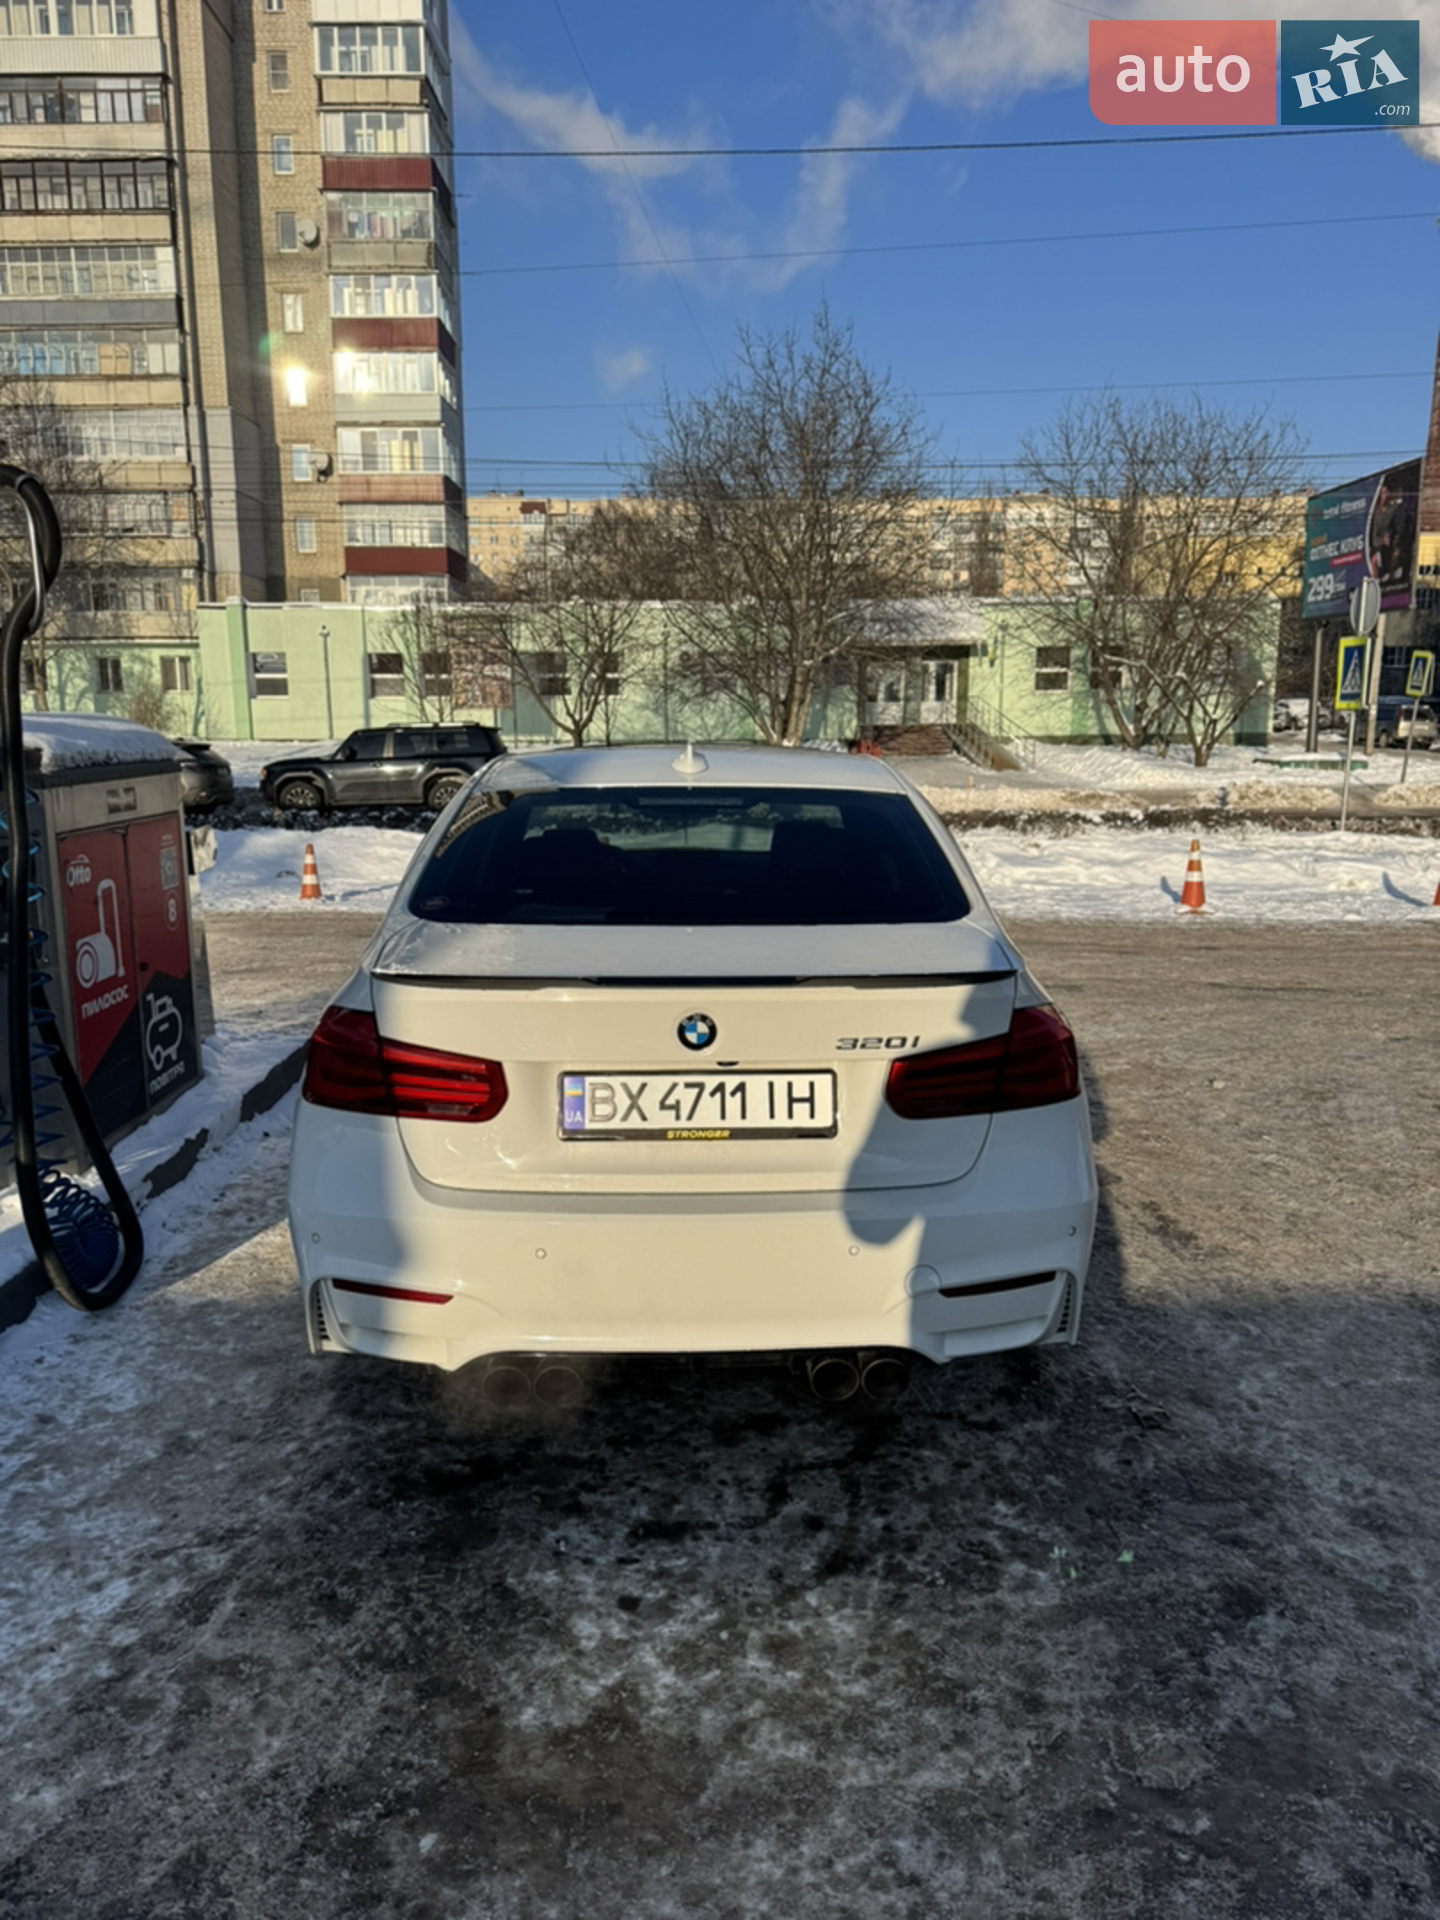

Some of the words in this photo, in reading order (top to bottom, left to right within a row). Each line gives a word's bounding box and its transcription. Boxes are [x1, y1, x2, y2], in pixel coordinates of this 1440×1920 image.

[1308, 573, 1334, 602] 299
[81, 984, 130, 1019] ПИЛОСОС
[588, 1082, 648, 1123] BX
[658, 1081, 747, 1122] 4711
[768, 1081, 815, 1120] IH
[564, 1111, 583, 1123] UA
[665, 1129, 731, 1139] STRONGER
